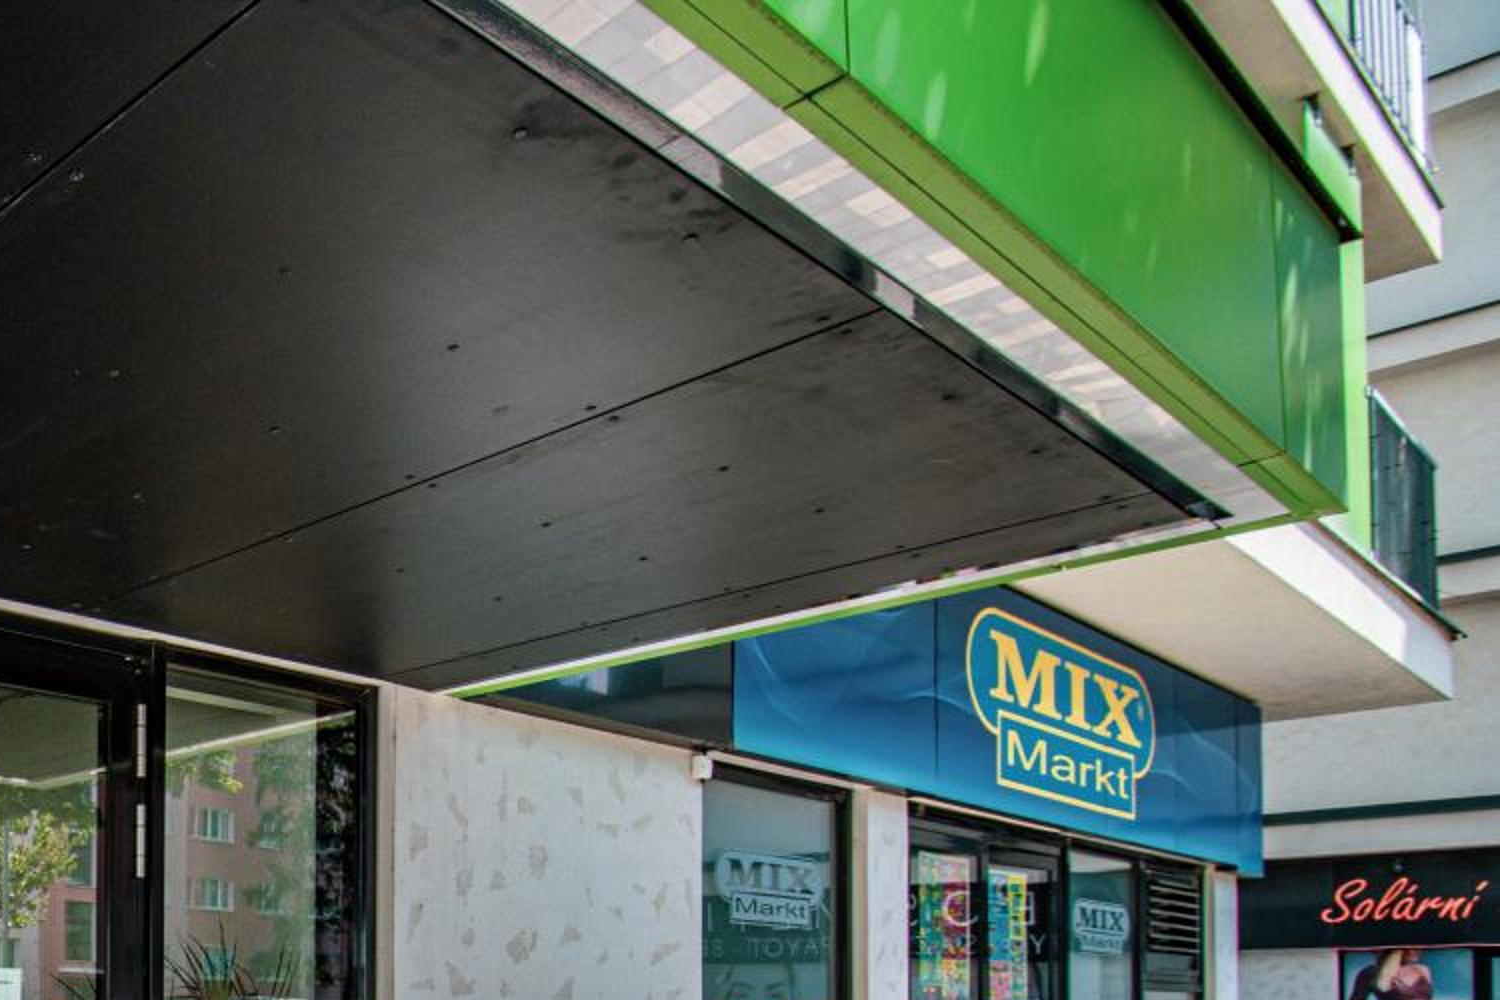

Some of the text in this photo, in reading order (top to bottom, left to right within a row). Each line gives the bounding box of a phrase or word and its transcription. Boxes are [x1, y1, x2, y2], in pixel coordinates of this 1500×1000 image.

[989, 629, 1142, 748] MIX
[1007, 729, 1129, 799] Markt
[723, 858, 816, 894] MIX
[735, 897, 804, 918] Markt
[1076, 906, 1125, 932] MIX
[1320, 876, 1490, 923] Solární
